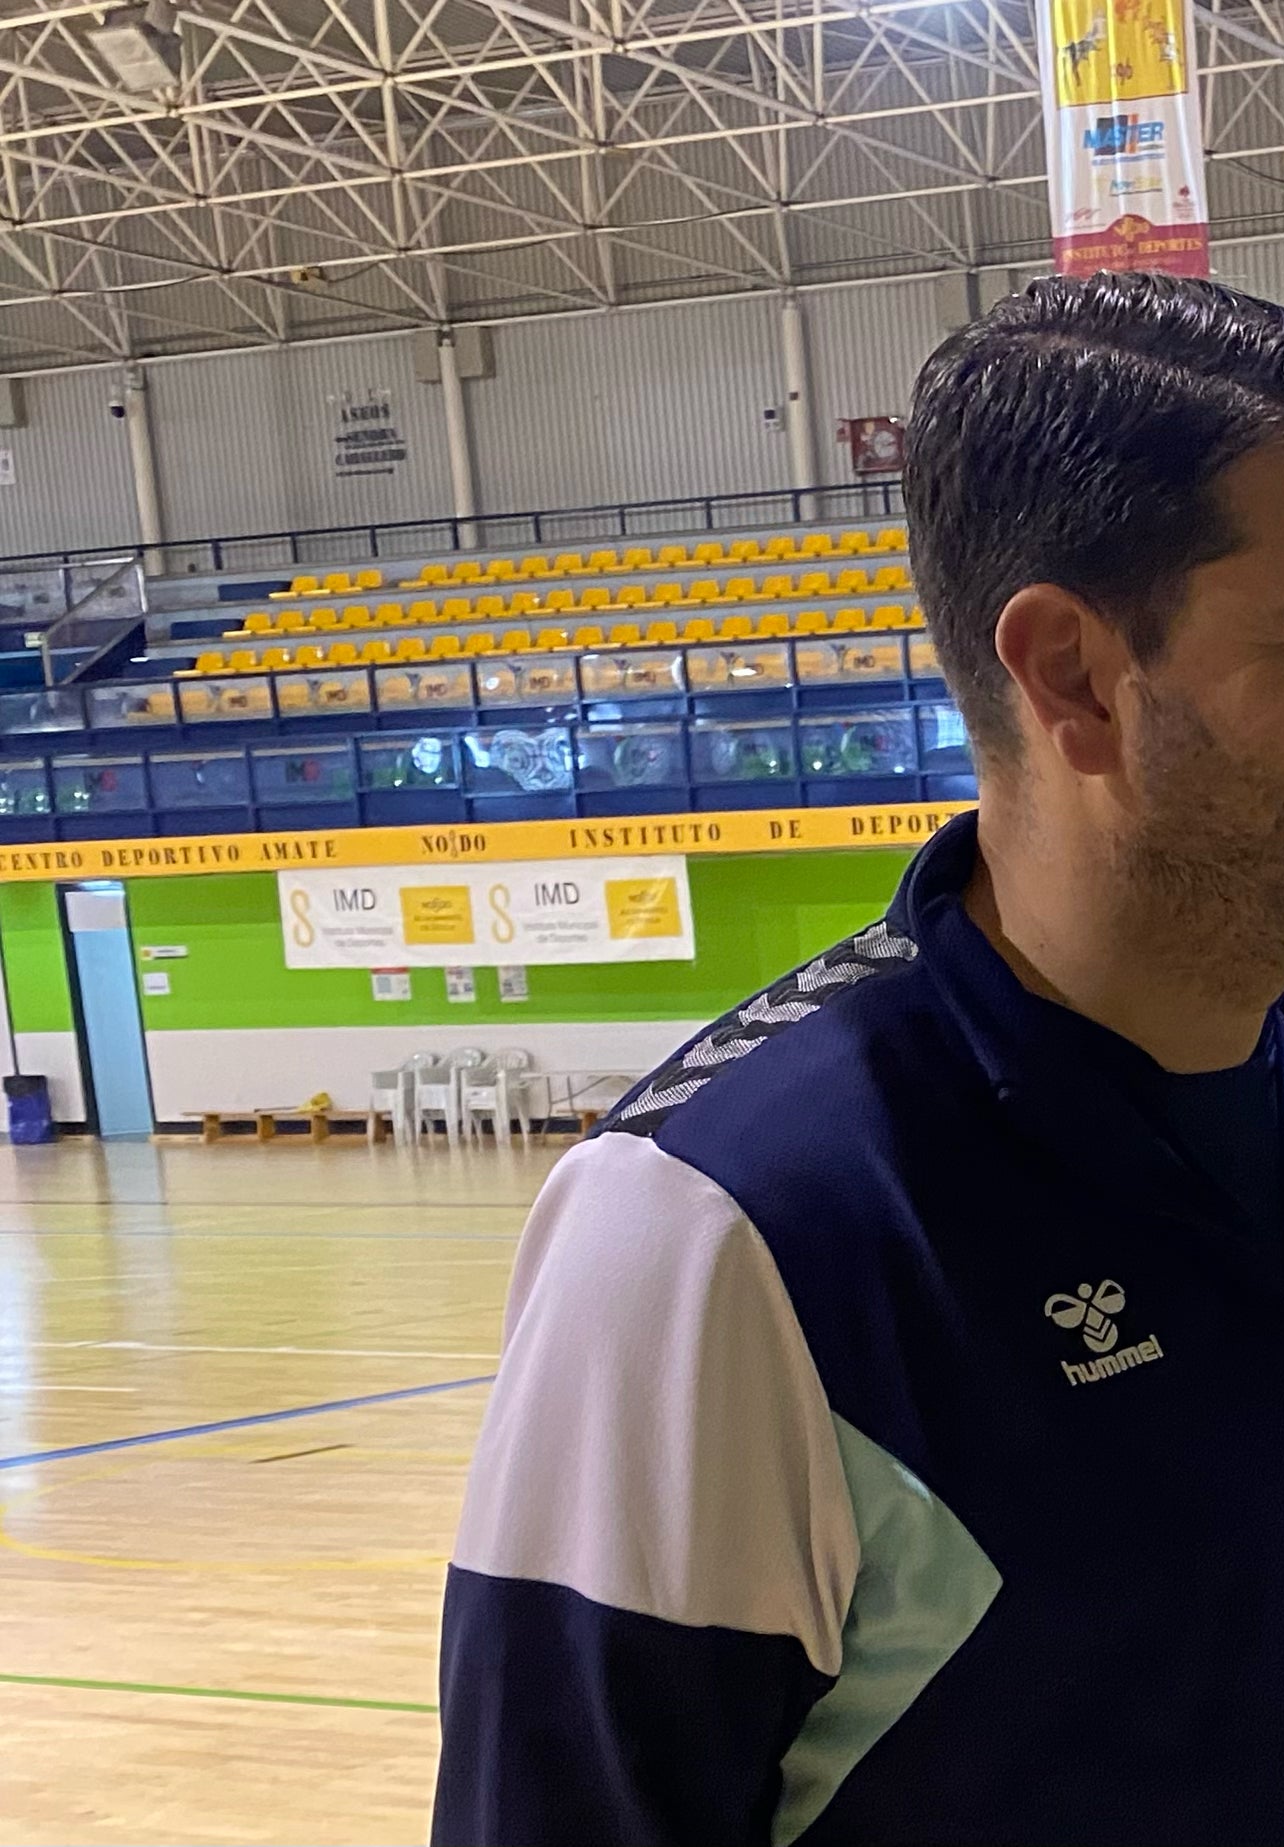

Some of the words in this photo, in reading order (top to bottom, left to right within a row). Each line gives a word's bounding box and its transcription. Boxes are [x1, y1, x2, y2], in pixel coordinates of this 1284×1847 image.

[570, 824, 721, 848] INSTITUTO
[770, 820, 802, 839] DE
[102, 844, 239, 867] DEPORTIVO
[260, 839, 338, 861] AMATE
[333, 888, 376, 911] IMD
[534, 882, 580, 906] IMD
[1061, 1334, 1164, 1386] hummel
